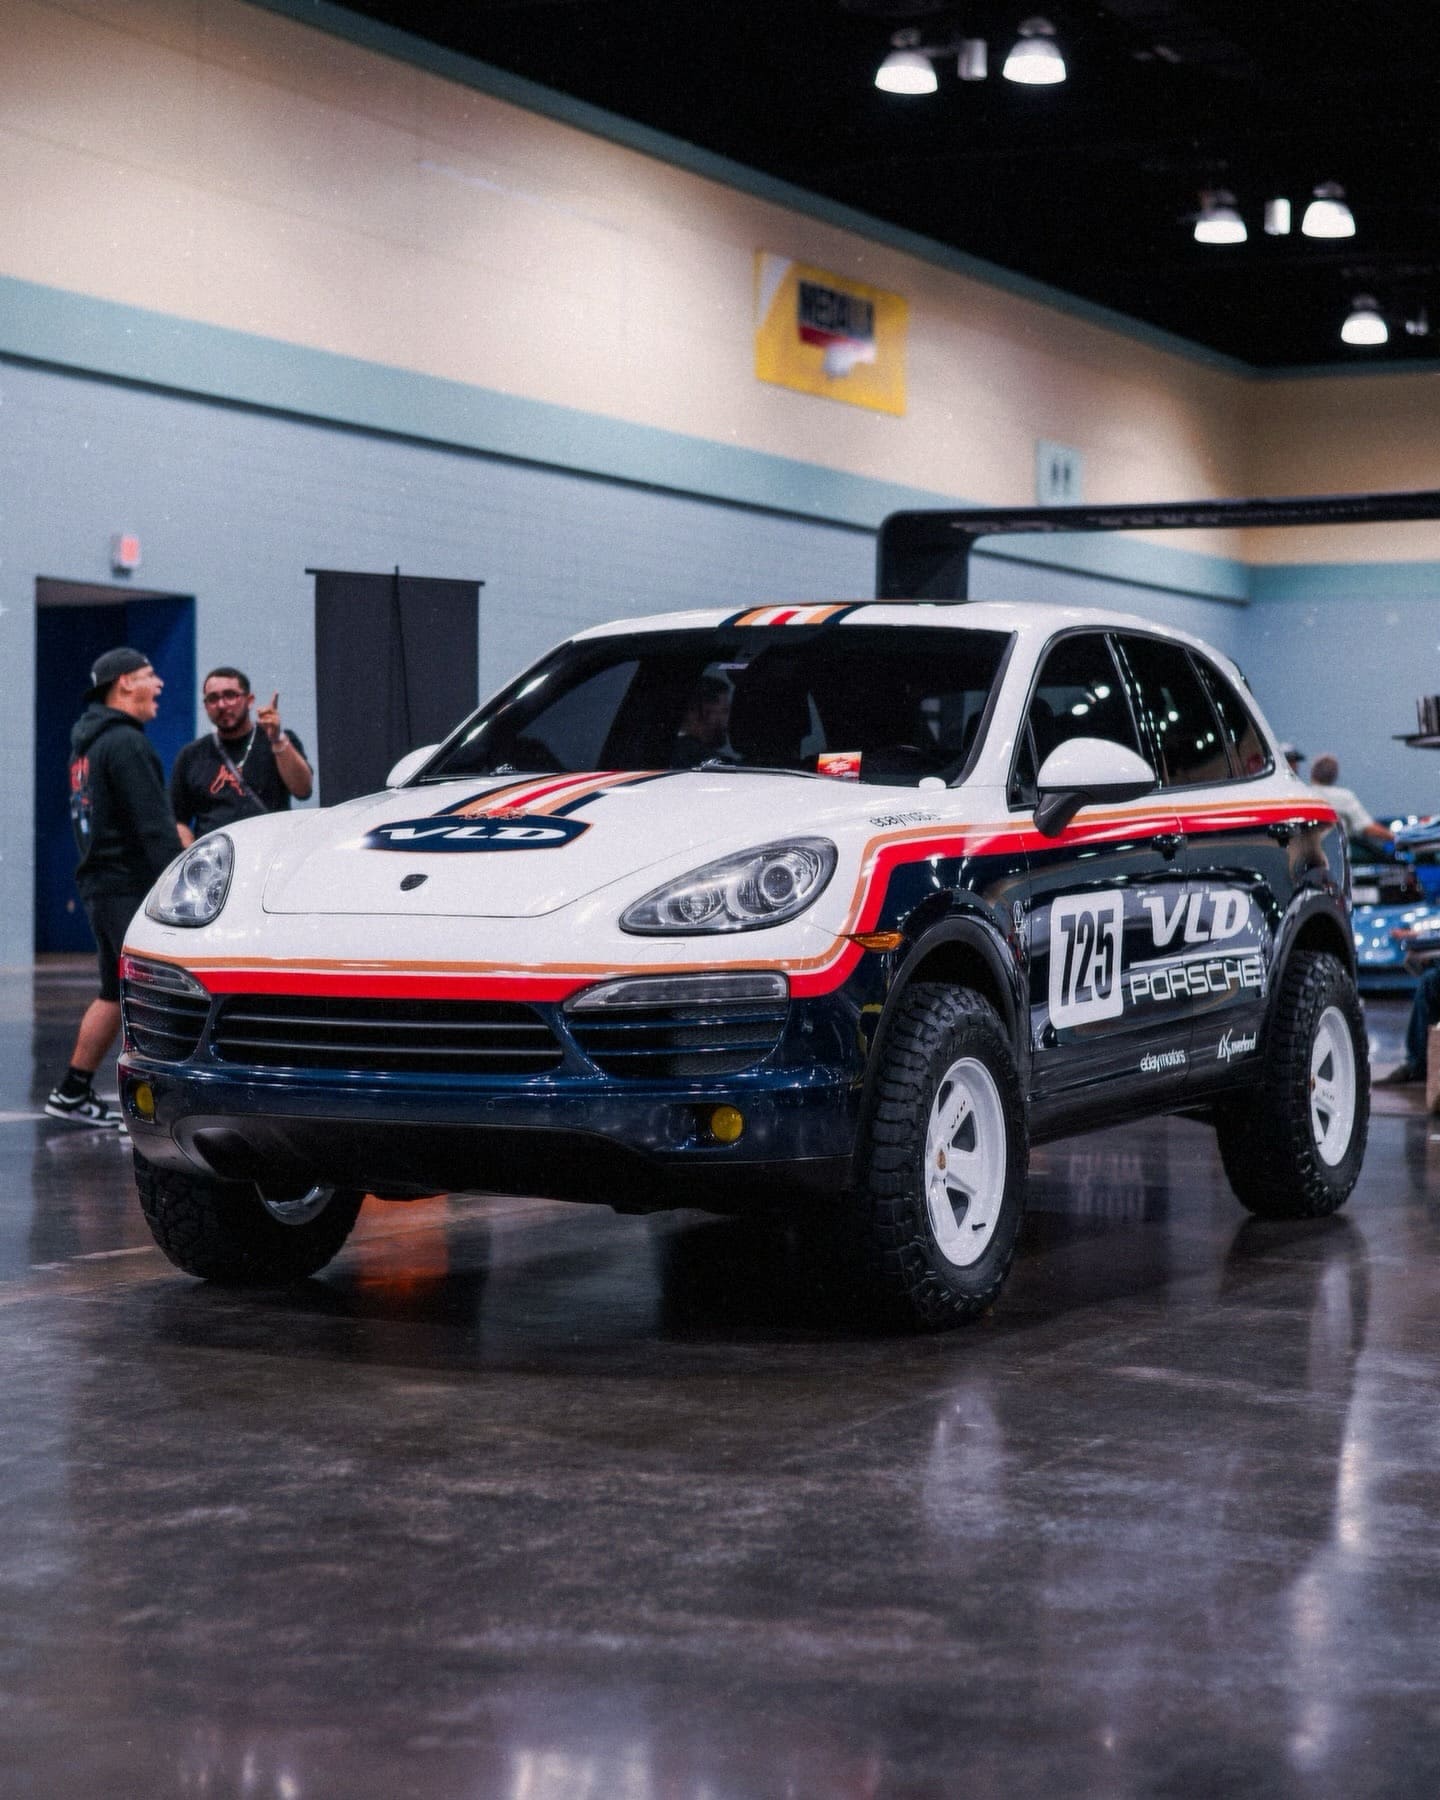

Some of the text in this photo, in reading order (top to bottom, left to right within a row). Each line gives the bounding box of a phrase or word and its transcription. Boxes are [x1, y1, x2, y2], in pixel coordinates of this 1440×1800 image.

[379, 826, 567, 841] VLD
[1142, 890, 1250, 947] VLD
[1060, 908, 1115, 1007] 725
[1130, 956, 1262, 1005] PORSCHE
